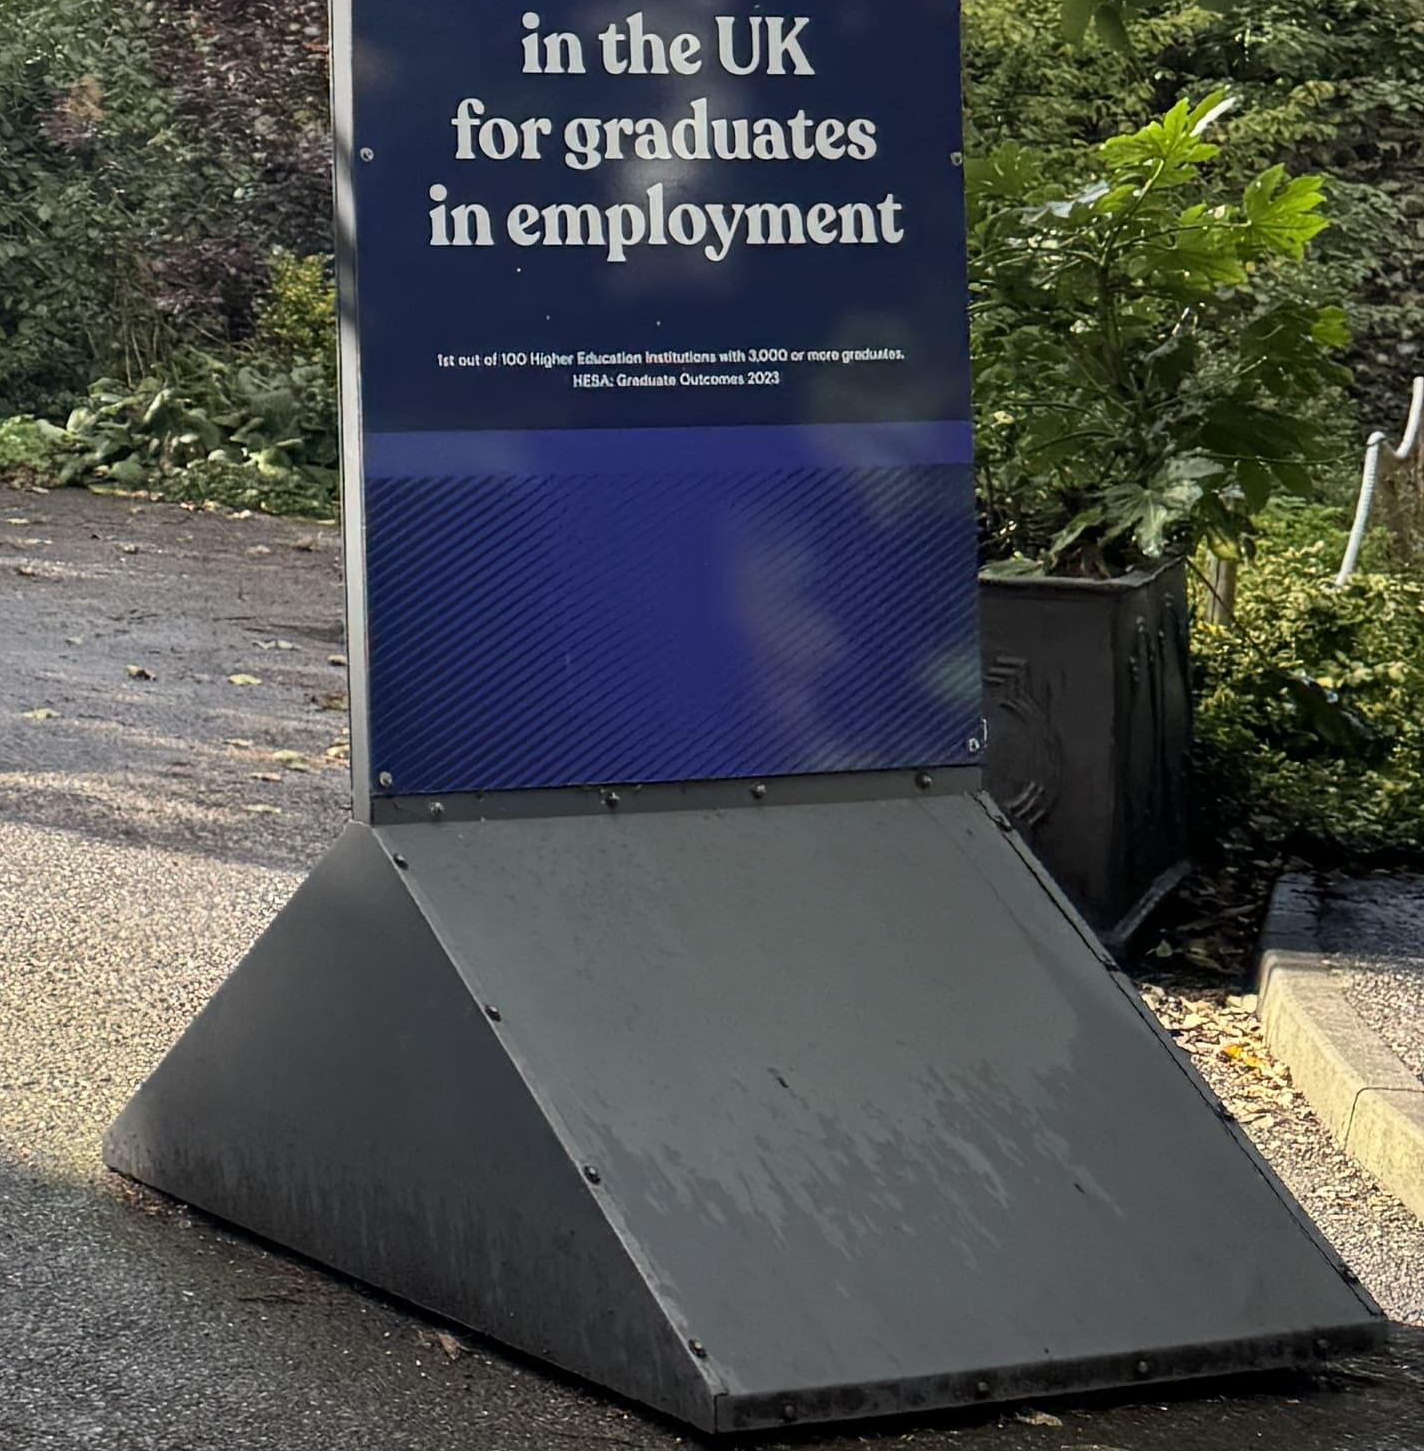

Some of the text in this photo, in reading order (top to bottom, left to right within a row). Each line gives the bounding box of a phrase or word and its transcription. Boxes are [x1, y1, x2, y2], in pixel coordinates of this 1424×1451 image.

[521, 11, 815, 75] in the UK
[451, 97, 877, 170] for graduates
[429, 181, 904, 262] in employment
[437, 353, 455, 367] 1st
[458, 353, 481, 367] out
[483, 352, 498, 366] of
[501, 351, 528, 366] 100
[530, 351, 574, 369] Higher
[577, 351, 642, 366] Education
[645, 350, 717, 365] Institutions
[719, 348, 746, 363] with
[791, 351, 804, 361] or
[807, 350, 840, 361] more
[573, 370, 780, 388] HESA: Graduate Outcomes 2023
